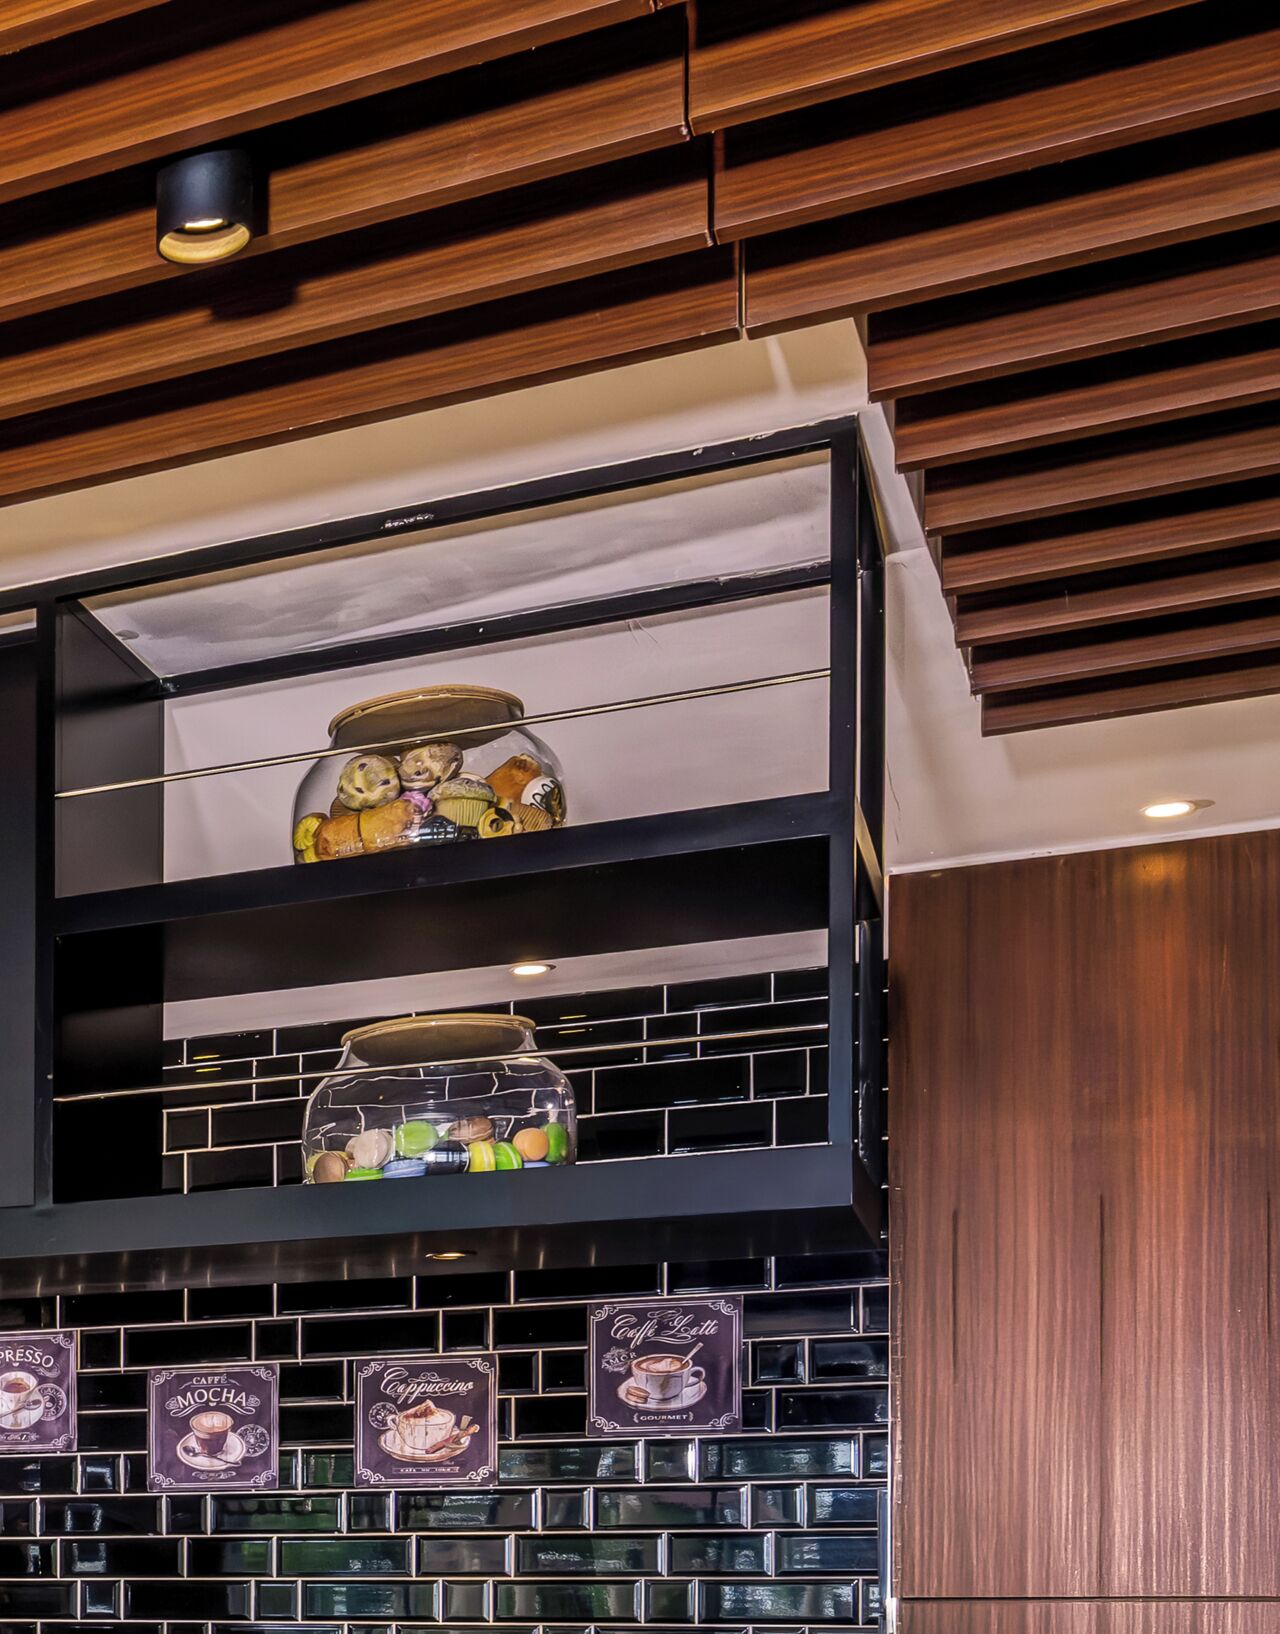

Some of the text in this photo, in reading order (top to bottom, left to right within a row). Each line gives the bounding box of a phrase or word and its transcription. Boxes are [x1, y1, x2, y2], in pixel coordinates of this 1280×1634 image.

[661, 1314, 719, 1337] Latte
[381, 1367, 474, 1404] Cappuccino
[176, 1388, 247, 1408] MOCHA
